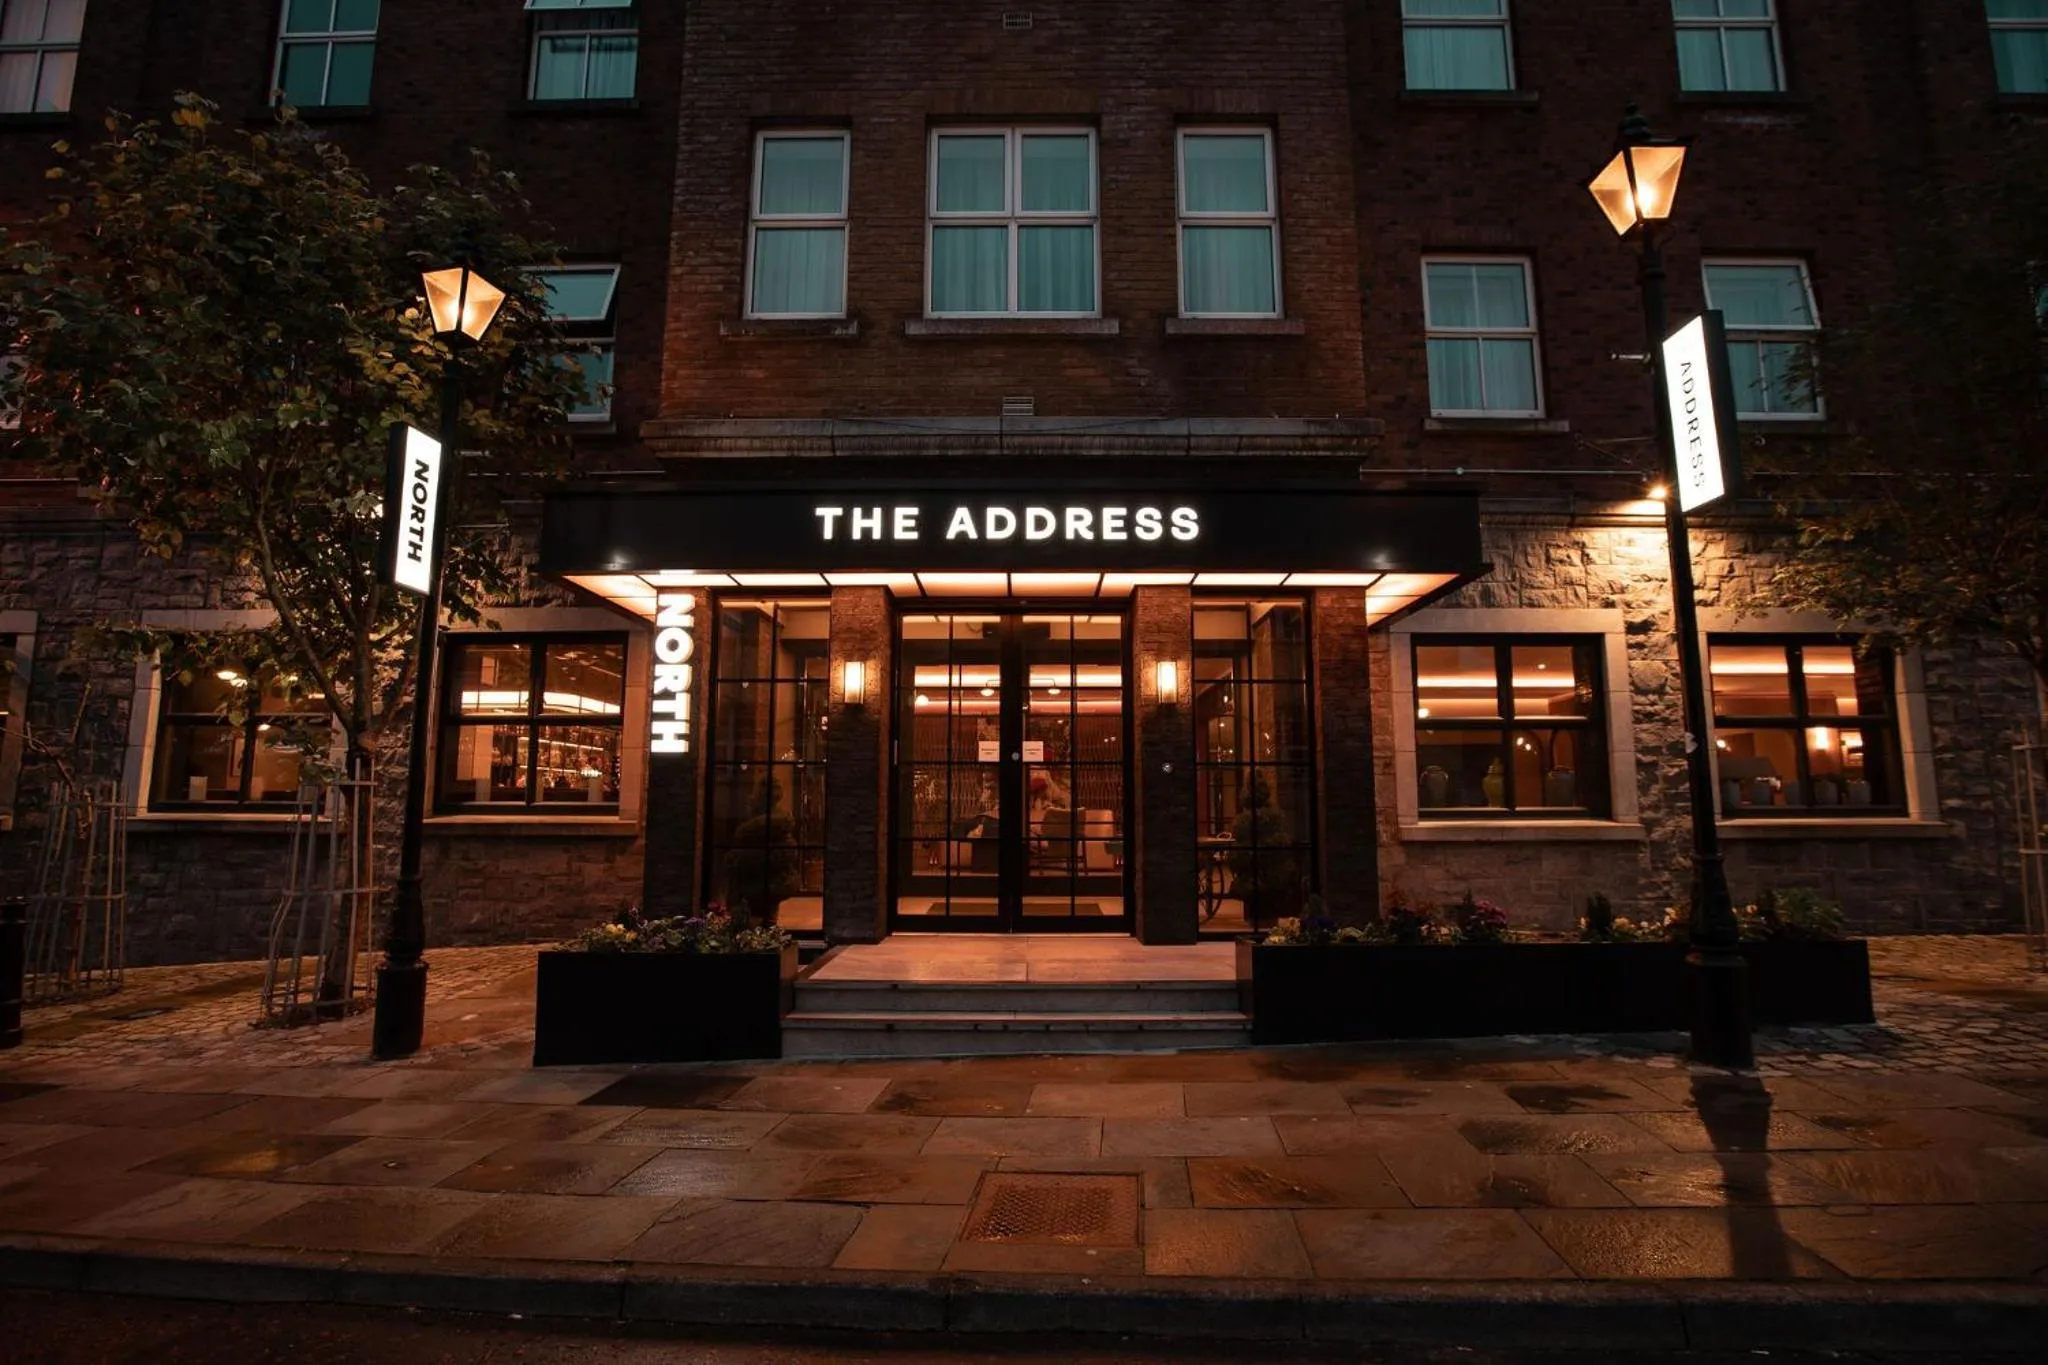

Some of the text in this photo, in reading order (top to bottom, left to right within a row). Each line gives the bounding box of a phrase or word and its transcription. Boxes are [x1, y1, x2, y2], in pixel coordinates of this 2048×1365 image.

[1680, 361, 1705, 488] ADDRESS
[406, 458, 430, 563] NORTH
[815, 507, 1200, 540] THE ADDRESS
[651, 593, 695, 753] NORTH
